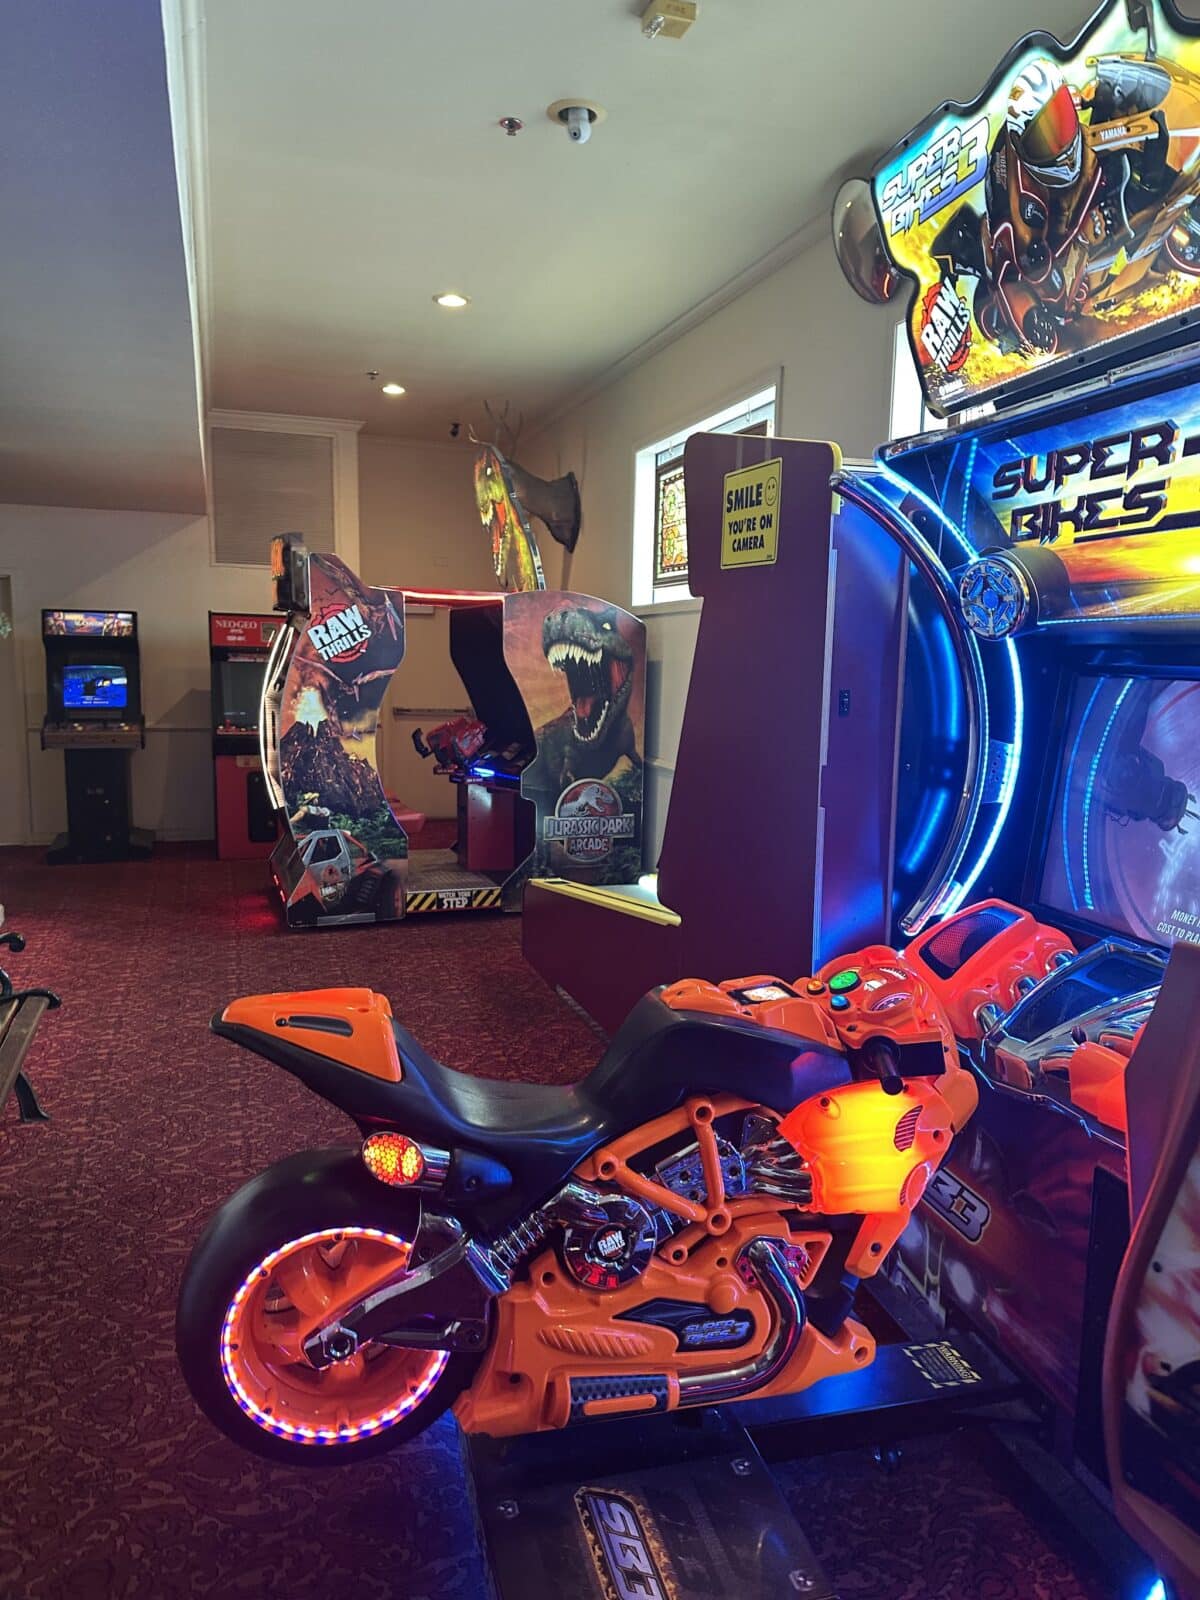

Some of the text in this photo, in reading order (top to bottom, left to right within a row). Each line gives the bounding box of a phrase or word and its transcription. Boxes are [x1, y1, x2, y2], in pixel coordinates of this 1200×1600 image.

[882, 126, 961, 212] SUPER
[890, 160, 959, 237] BIKES
[921, 276, 960, 361] RAW
[935, 302, 970, 372] THRILLS
[992, 419, 1180, 500] SUPER
[727, 483, 763, 513] SMILE
[1010, 478, 1167, 545] BIKES
[728, 513, 773, 535] YOU'RE ON
[732, 535, 764, 553] CAMERA
[307, 604, 364, 650] RAW
[318, 624, 372, 661] THRILLS
[546, 817, 631, 837] JURASSIC PARK
[570, 838, 609, 851] ARCADE
[442, 897, 469, 910] STEP
[1171, 909, 1198, 926] MONEY
[1156, 921, 1200, 944] COST TO PLA
[922, 1168, 991, 1242] B3
[598, 1230, 622, 1250] RAW
[938, 1344, 972, 1379] WARNING!
